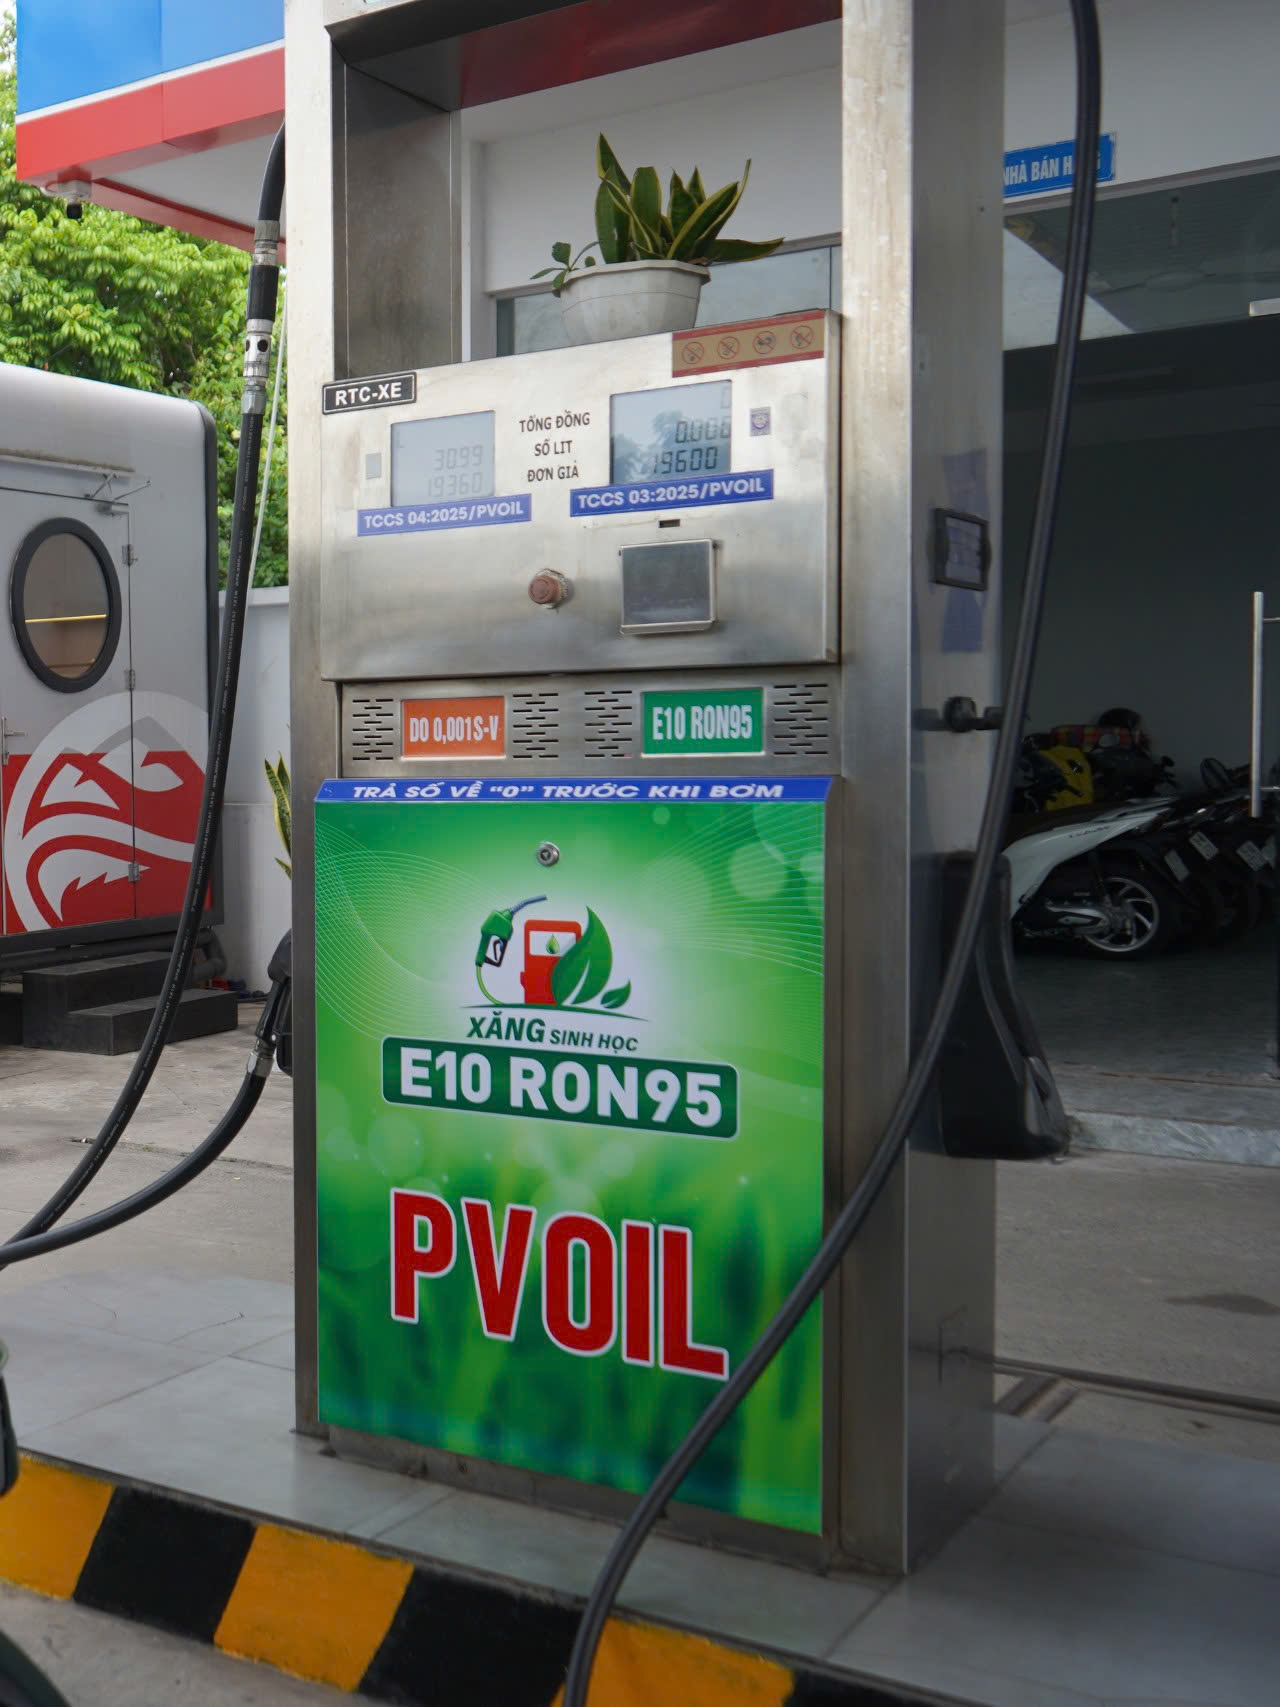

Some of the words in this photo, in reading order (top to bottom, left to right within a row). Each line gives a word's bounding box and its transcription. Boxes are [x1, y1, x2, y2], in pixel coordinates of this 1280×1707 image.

[1031, 156, 1059, 181] BÁN
[336, 382, 402, 406] RTC-XE
[554, 440, 572, 454] LIT
[527, 467, 554, 482] ĐƠN
[578, 491, 624, 509] TCCS
[629, 478, 765, 504] 03:2025/PVOIL
[364, 513, 404, 529] TCCS
[408, 501, 524, 525] 04:2025/PVOIL
[652, 706, 686, 740] E10
[691, 705, 752, 740] RON95
[353, 782, 397, 798] TRẢ
[405, 781, 445, 798] SỐ
[450, 781, 484, 798] VỀ
[543, 782, 640, 798] TRƯỚC
[648, 785, 701, 798] KHI
[709, 783, 784, 798] BƠM
[466, 1010, 546, 1043] XĂNG
[550, 1029, 593, 1050] SINH
[597, 1034, 639, 1054] HỌC
[400, 1046, 491, 1104] E10
[509, 1055, 723, 1128] RON95
[390, 1187, 730, 1382] PVOIL
